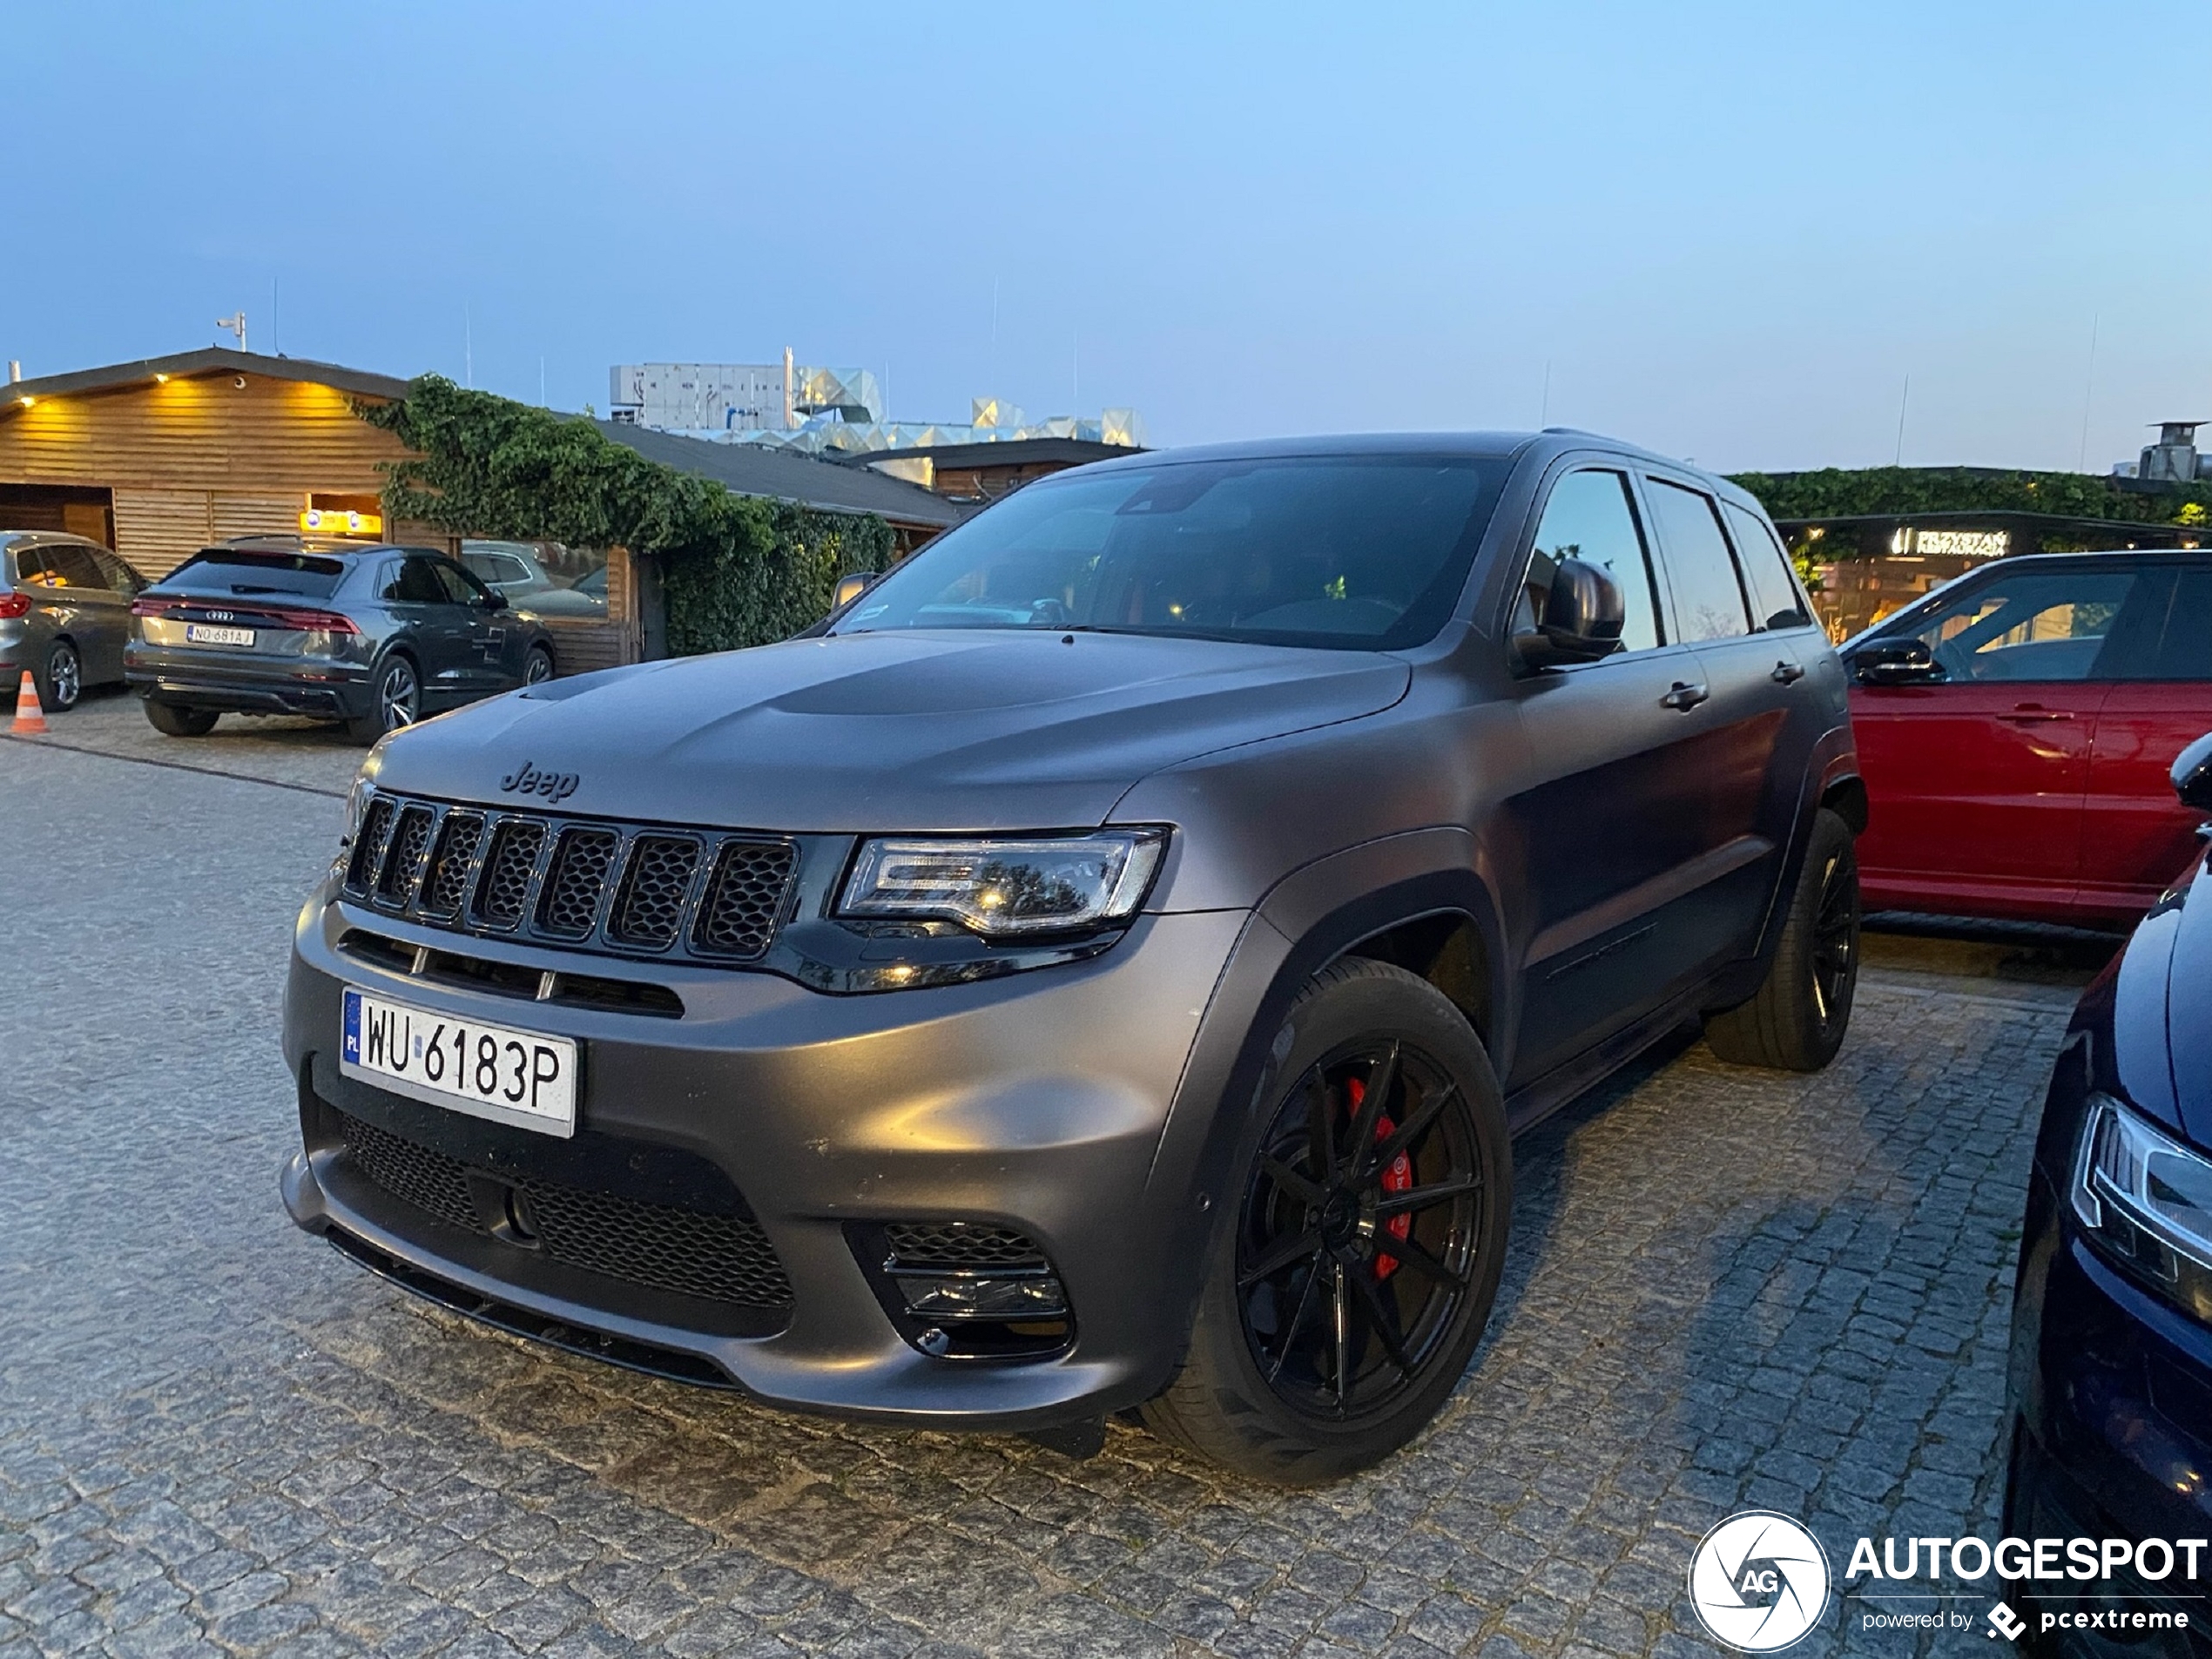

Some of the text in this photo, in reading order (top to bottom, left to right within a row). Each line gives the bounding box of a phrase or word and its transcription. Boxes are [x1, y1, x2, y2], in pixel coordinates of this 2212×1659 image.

[500, 759, 580, 804] Jeep
[347, 1035, 360, 1053] PL
[368, 1006, 560, 1109] WU 6183P
